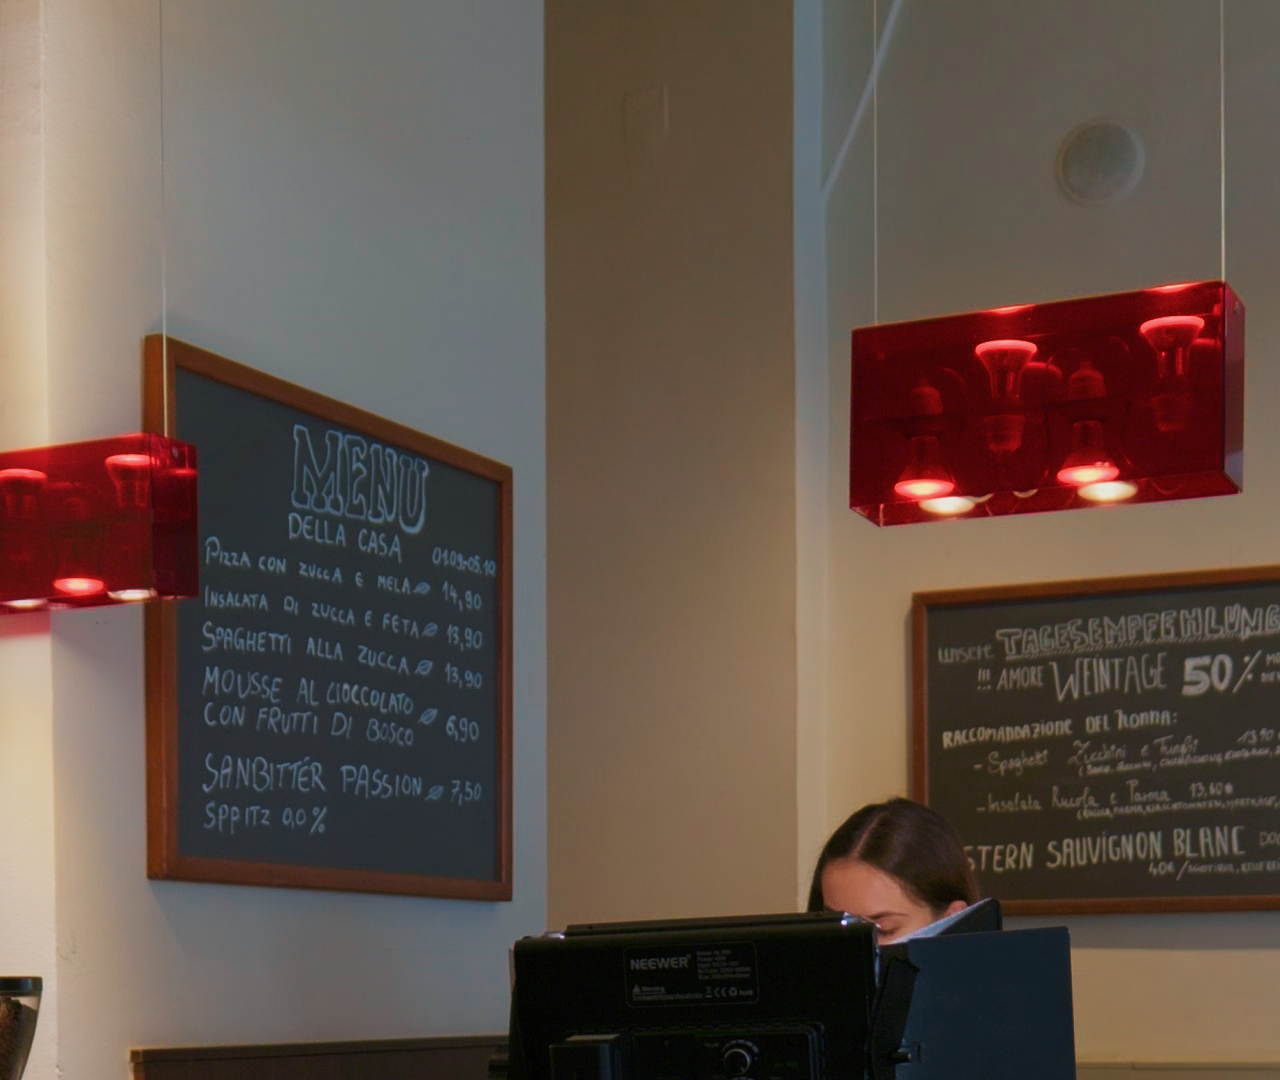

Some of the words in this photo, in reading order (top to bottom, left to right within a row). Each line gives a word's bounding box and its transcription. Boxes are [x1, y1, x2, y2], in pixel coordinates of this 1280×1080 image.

[291, 424, 429, 534] MENU
[288, 512, 345, 547] DELLA
[358, 528, 402, 563] CASA
[205, 536, 251, 568] PIZZA
[259, 554, 287, 574] CON
[298, 561, 342, 584] ZUCCA
[378, 575, 410, 595] MELA
[442, 580, 482, 611] 14,90
[204, 585, 269, 611] INSALATA
[283, 597, 298, 615] DI
[311, 602, 355, 626] ZUCCA
[364, 610, 372, 626] E
[382, 613, 419, 638] FETA
[447, 623, 483, 651] 13,90
[201, 621, 291, 655] SPAGHETTI
[306, 637, 343, 662] ALLA
[357, 645, 409, 675] ZUCCA
[445, 662, 482, 689] 13,90
[997, 665, 1044, 690] AMORE
[202, 666, 282, 703] MOUSSE
[297, 678, 318, 706] AL
[326, 682, 413, 715] CIOCCOLATO
[204, 702, 245, 726] CON
[255, 706, 318, 735] FRUTTI
[330, 712, 352, 740] DI
[366, 718, 414, 747] BOSCO
[445, 716, 479, 743] 6,90
[340, 764, 423, 799] PASSION
[450, 780, 482, 806] 7,50
[1046, 830, 1162, 869] SAUVIGNON
[1173, 825, 1245, 858] BLANC
[630, 956, 689, 971] NEEWER
